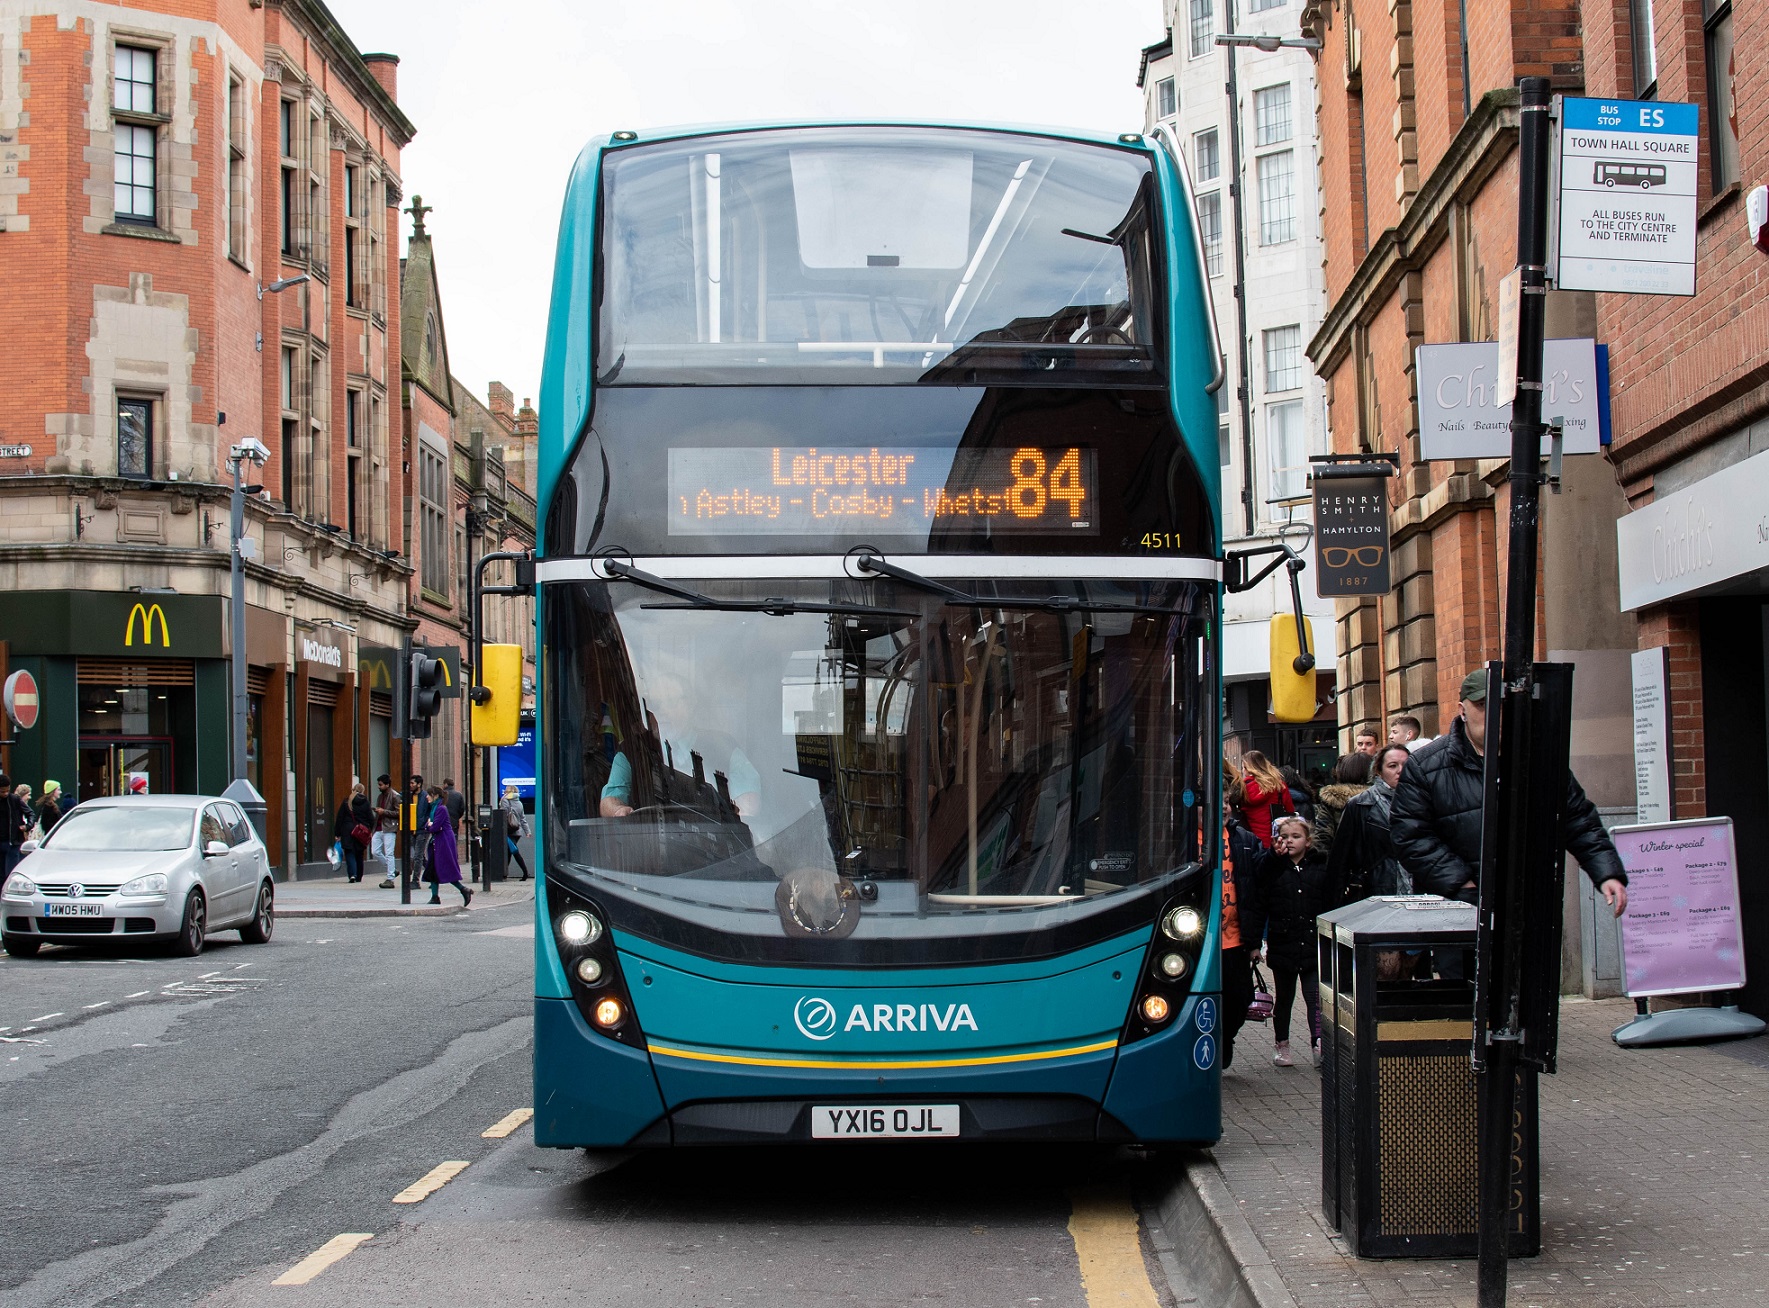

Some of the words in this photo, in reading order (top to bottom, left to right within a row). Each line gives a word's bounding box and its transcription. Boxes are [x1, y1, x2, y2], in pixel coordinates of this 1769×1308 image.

[1600, 105, 1619, 115] BUS
[1597, 116, 1622, 126] STOP
[1639, 108, 1665, 128] ES
[1571, 137, 1607, 149] TOWN
[1611, 140, 1640, 151] HALL
[1643, 141, 1690, 153] SQUARE
[1592, 209, 1610, 219] ALL
[1612, 211, 1642, 221] BUSES
[1645, 212, 1666, 222] RUN
[1581, 219, 1594, 229] TO
[1596, 220, 1615, 230] THE
[1617, 221, 1639, 231] CITY
[1641, 222, 1677, 233] CENTRE
[1589, 231, 1611, 241] AND
[1613, 232, 1668, 243] TERMINATE
[1623, 264, 1669, 275] traveline
[1438, 422, 1465, 432] Nails
[1473, 421, 1509, 434] Beauty
[0, 447, 26, 456] TREET
[772, 447, 914, 486] Leicester
[1011, 447, 1085, 518] 84
[697, 487, 780, 519] Astley
[812, 487, 893, 519] Cosby
[1321, 496, 1379, 505] HENRY
[1322, 506, 1380, 515] SMITH
[1323, 526, 1381, 535] HAMYLTON
[1140, 532, 1182, 549] 4511
[1339, 577, 1368, 586] 1887
[303, 638, 341, 668] McDonald's
[1639, 841, 1674, 853] Winter
[1675, 837, 1705, 851] special
[80, 905, 101, 916] HMU
[844, 1003, 979, 1032] ARRIVA
[828, 1109, 885, 1133] YX16
